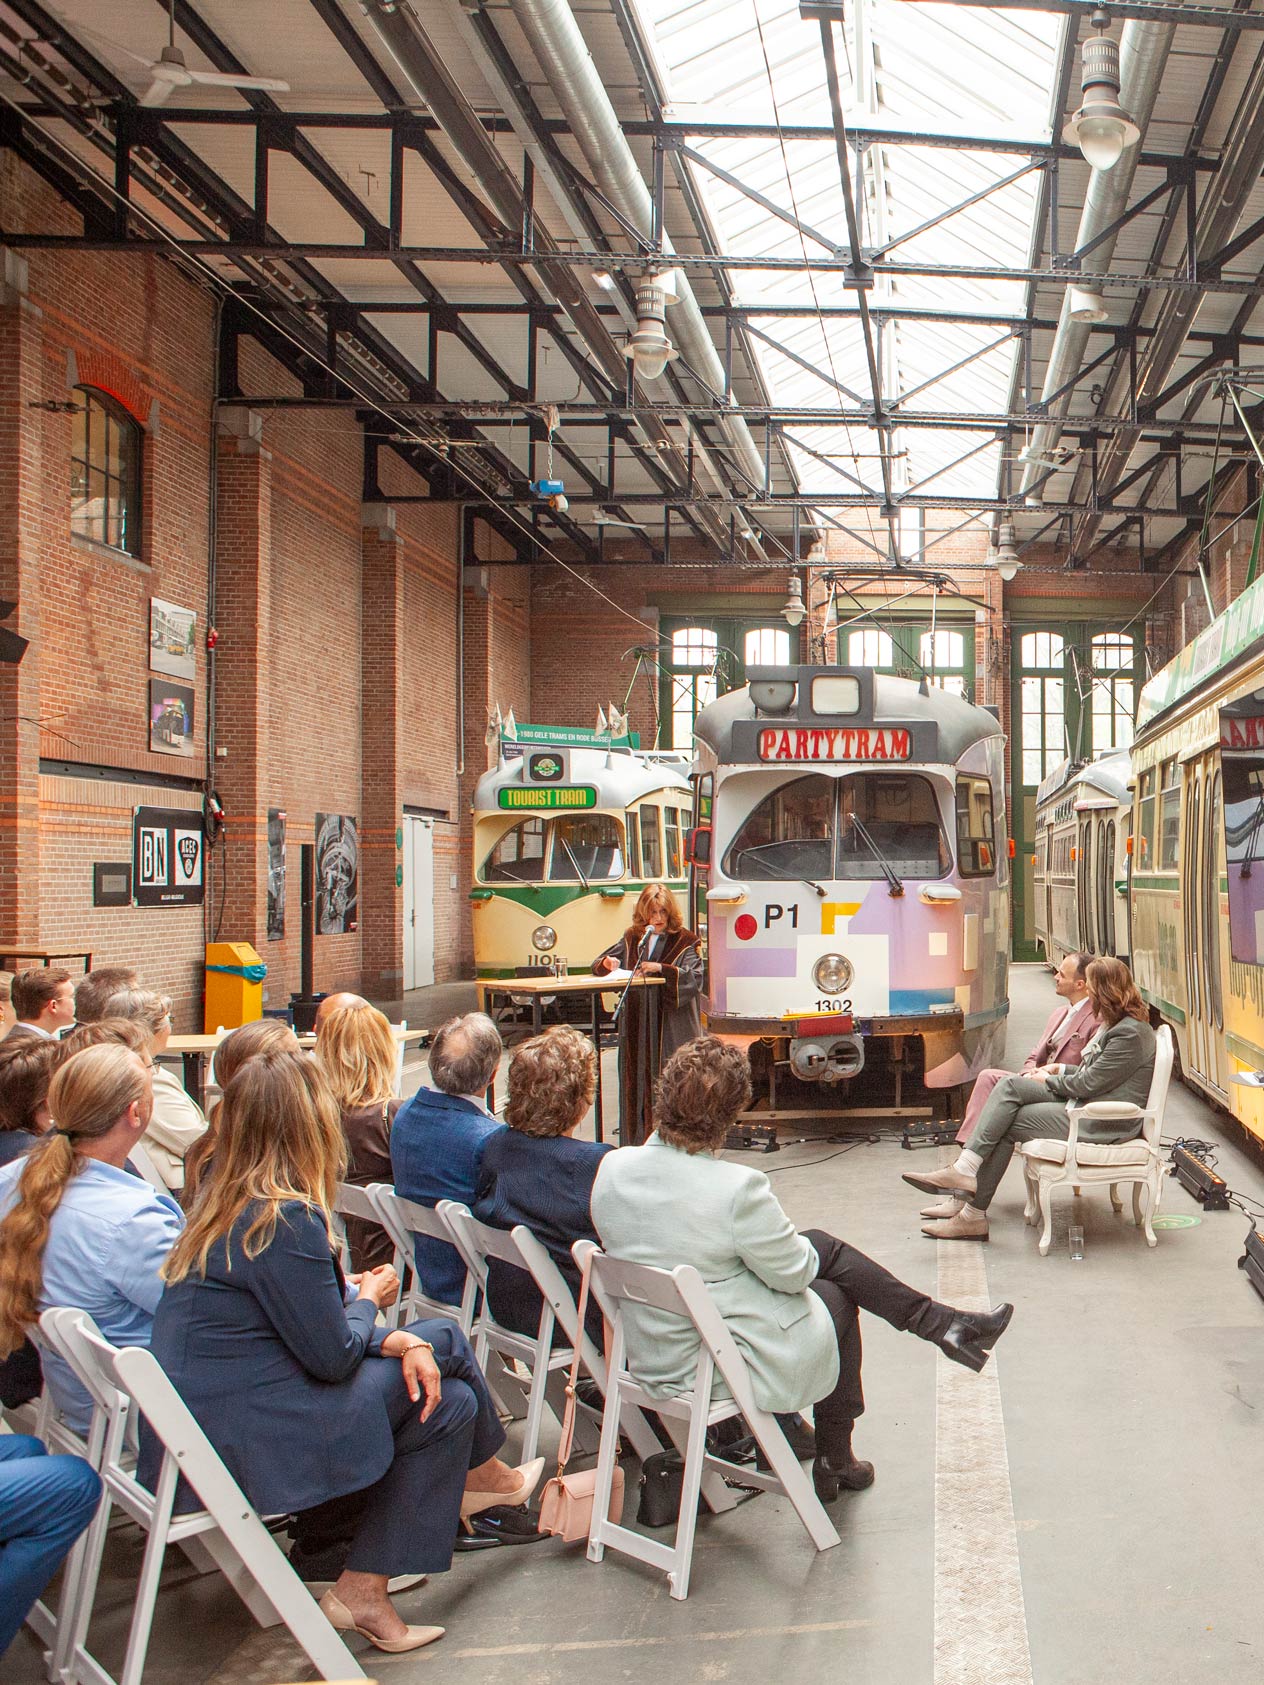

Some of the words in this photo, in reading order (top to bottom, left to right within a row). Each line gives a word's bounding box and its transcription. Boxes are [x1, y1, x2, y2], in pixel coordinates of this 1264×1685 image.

[761, 729, 910, 760] PARTYTRAM
[507, 790, 551, 806] TOURIST
[555, 790, 587, 806] TRAM
[142, 832, 166, 879] BN
[181, 840, 196, 854] ACEC
[765, 904, 799, 928] P1
[815, 1000, 853, 1013] 1302
